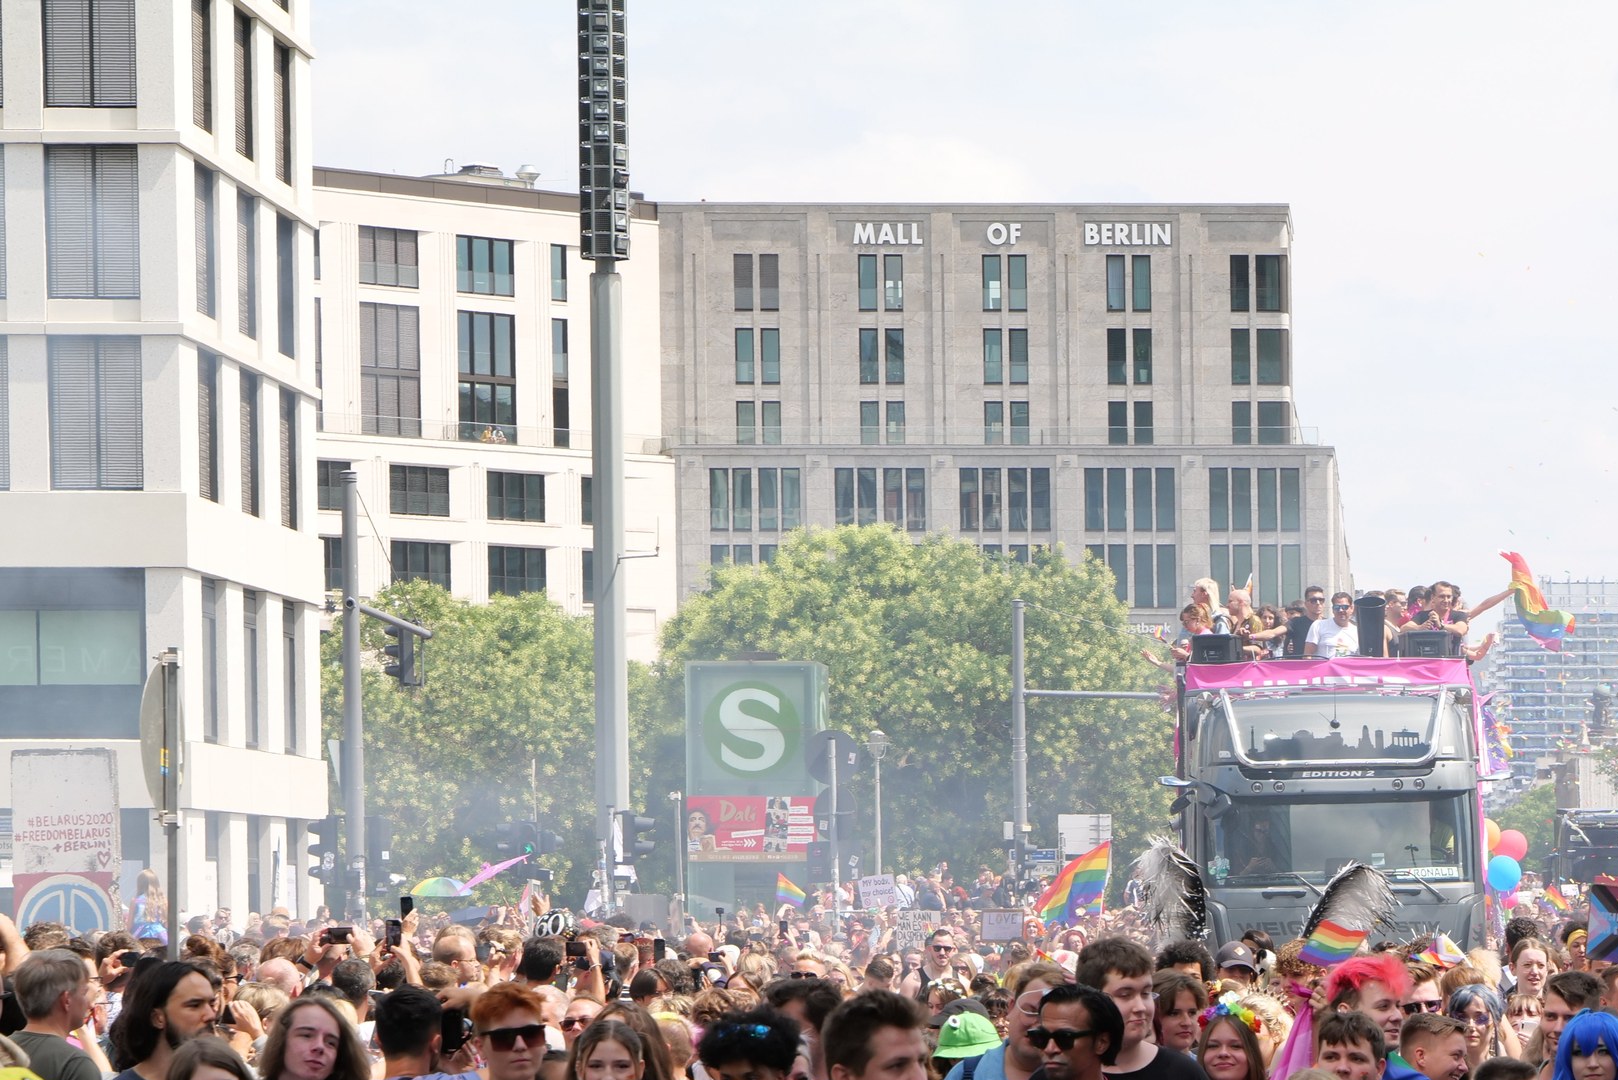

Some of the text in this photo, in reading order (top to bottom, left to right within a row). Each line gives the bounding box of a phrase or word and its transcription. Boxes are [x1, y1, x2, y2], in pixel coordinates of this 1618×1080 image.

[853, 223, 1171, 245] MALL OF BERLIN
[719, 688, 786, 771] S
[1301, 769, 1376, 778] EDITION 2
[27, 812, 113, 827] #BELARUS2020
[14, 827, 111, 842] #FREEDOMBELARUS
[1413, 867, 1454, 877] RONALD
[913, 911, 932, 921] KANN
[988, 913, 1018, 925] LOVE
[535, 913, 565, 938] 60
